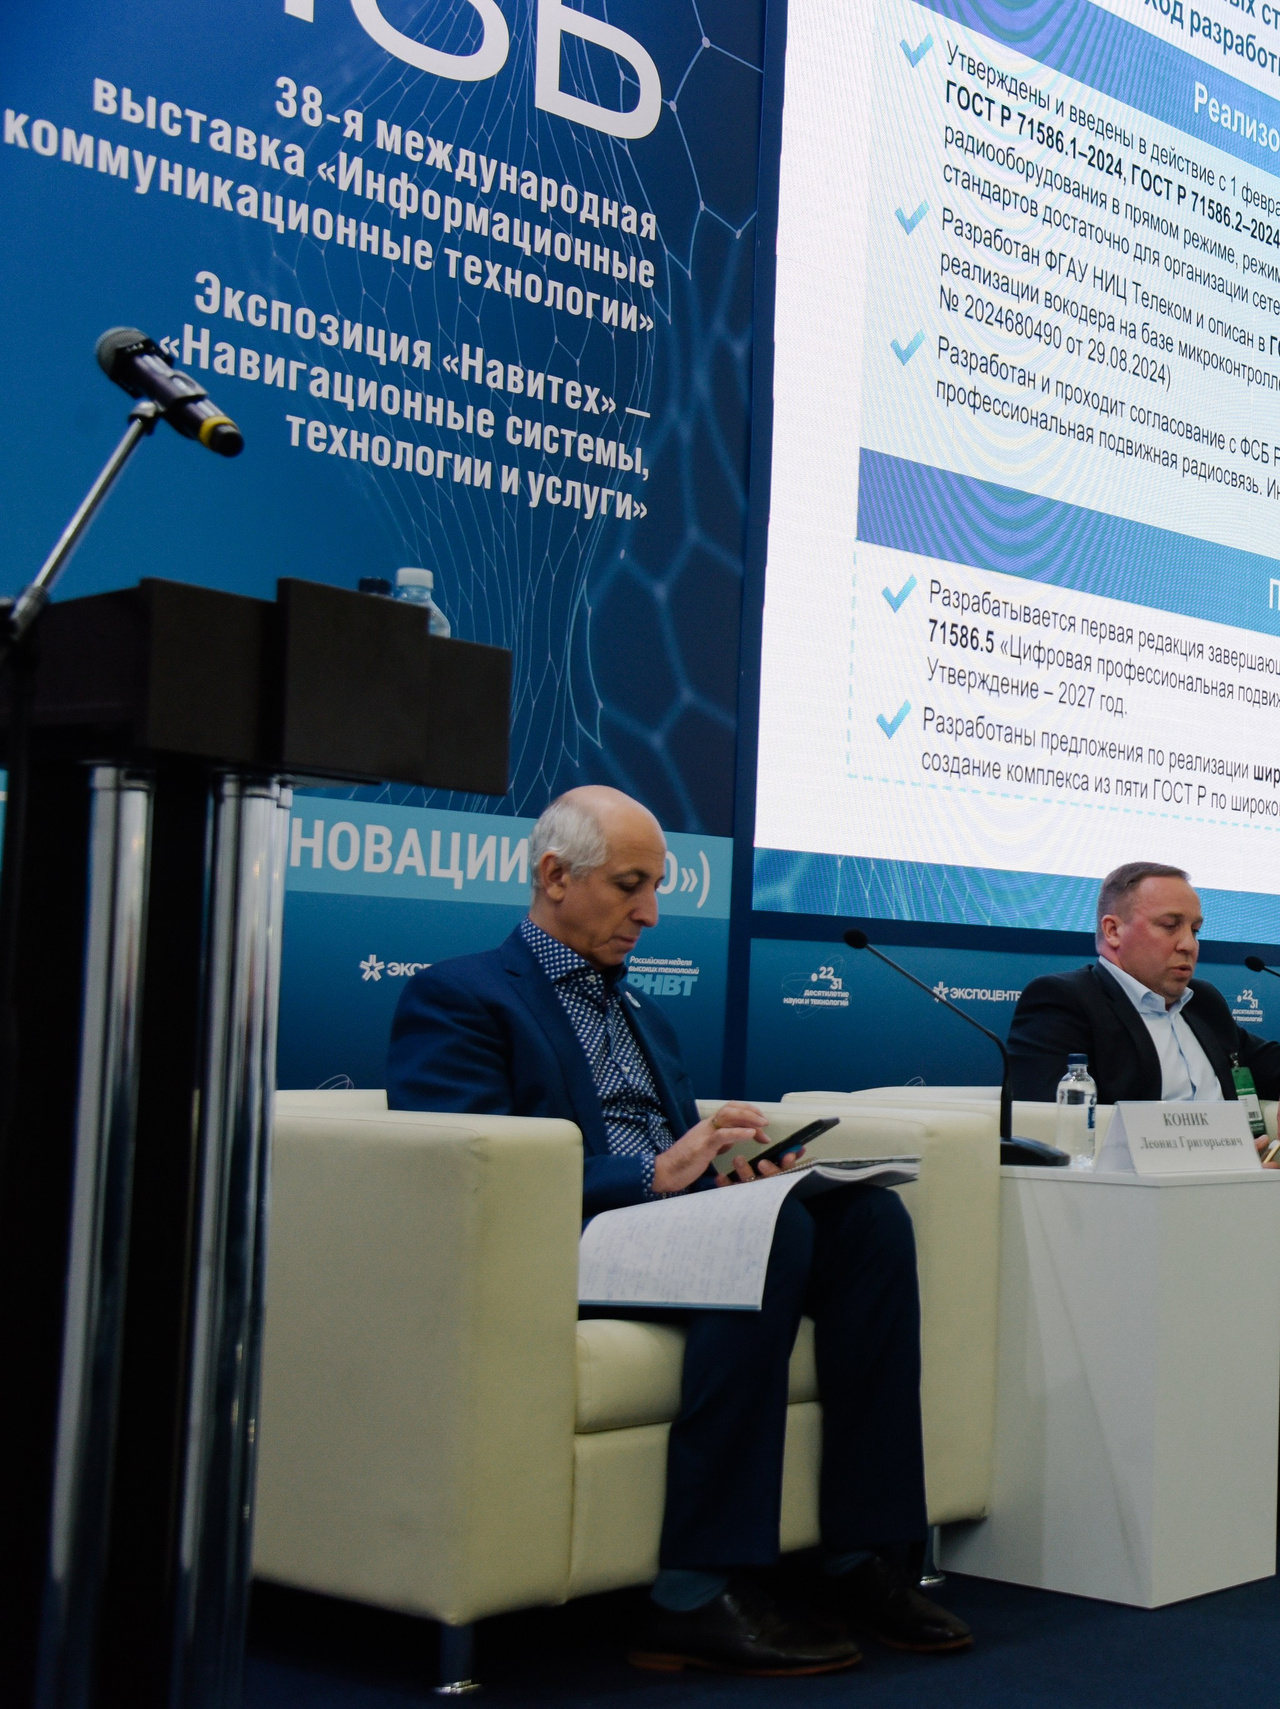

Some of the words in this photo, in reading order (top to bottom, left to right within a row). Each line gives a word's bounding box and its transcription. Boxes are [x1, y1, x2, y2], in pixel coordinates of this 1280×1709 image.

[274, 76, 364, 139] 38-я
[376, 118, 657, 241] международная
[945, 79, 996, 122] ГОСТ
[1131, 163, 1174, 201] ГОСТ
[946, 40, 1050, 111] Утверждены
[1055, 98, 1065, 118] и
[1069, 104, 1134, 150] введены
[1138, 136, 1147, 156] в
[1149, 143, 1216, 187] действие
[1218, 174, 1227, 192] с
[1230, 176, 1236, 197] 1
[2, 108, 435, 271] коммуникационные
[443, 248, 655, 332] технологии»
[93, 77, 306, 178] выставка
[317, 152, 656, 288] «Информационные
[941, 206, 1040, 267] Разработан
[1044, 249, 1089, 284] ФГАУ
[1092, 266, 1128, 306] НИЦ
[1131, 280, 1193, 325] Телеком
[1196, 312, 1204, 330] и
[1208, 316, 1254, 349] описан
[1258, 335, 1266, 353] в
[194, 271, 432, 372] Экспозиция
[442, 343, 618, 417] «Навитех»
[939, 284, 959, 313] №
[964, 294, 1062, 350] 2024680490
[1066, 335, 1084, 357] от
[1087, 337, 1171, 392] 29.08.2024)
[159, 324, 495, 440] «Навигационные
[505, 408, 650, 481] системы,
[285, 413, 492, 498] технологии
[500, 464, 520, 495] и
[527, 470, 648, 522] услуги»
[929, 578, 1076, 633] Разрабатывается
[1080, 617, 1134, 645] первая
[1138, 630, 1204, 662] редакция
[927, 656, 1039, 700] Утверждение
[1058, 680, 1096, 708] 2027
[923, 706, 1036, 747] Разработаны
[1041, 731, 1144, 763] предложения
[1147, 747, 1165, 767] по
[1168, 751, 1249, 782] реализации
[291, 817, 529, 890] НОВАЦИИ
[630, 956, 668, 965] Российская
[669, 958, 693, 966] неделя
[658, 967, 700, 975] технологий
[819, 966, 834, 979] 22
[830, 978, 842, 990] 31
[1242, 989, 1254, 1000] 22
[1140, 1137, 1178, 1150] Леонид
[1179, 1136, 1244, 1151] Григорьевич
[1163, 1111, 1210, 1127] КОНИК
